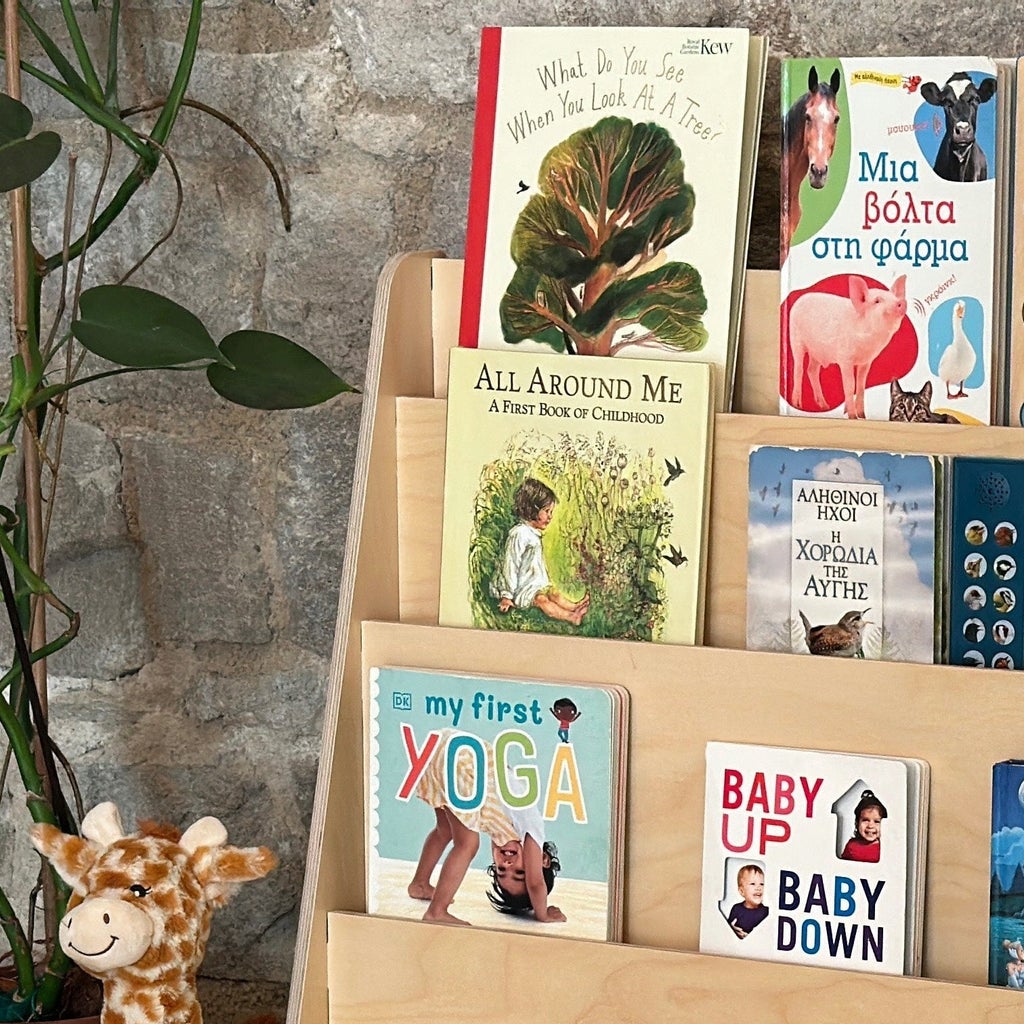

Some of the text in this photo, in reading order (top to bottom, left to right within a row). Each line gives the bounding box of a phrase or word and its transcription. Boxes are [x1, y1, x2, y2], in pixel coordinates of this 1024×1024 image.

[701, 38, 733, 55] Kew
[537, 46, 684, 90] What Do You See
[507, 109, 555, 144] When
[558, 90, 584, 119] You
[591, 78, 627, 111] Look
[633, 83, 655, 111] At
[662, 92, 676, 118] A
[858, 151, 919, 183] Μια
[862, 187, 956, 230] βόλτα
[811, 229, 969, 267] στη φάρμα
[474, 363, 683, 404] ALL AROUND ME
[488, 399, 665, 425] A FIRST BOOK OF CHILDHOOD
[796, 487, 878, 508] ΑΛΗΘΙΝΟΙ
[817, 505, 857, 522] ΗΧΟΙ
[795, 539, 879, 566] ΧΟΡΩΔΙΑ
[831, 531, 841, 543] Η
[803, 574, 869, 601] ΑΥΓΗΣ
[823, 565, 849, 579] ΤΗΣ
[394, 694, 411, 709] DK
[425, 692, 543, 727] my first
[395, 722, 588, 824] YOGA
[722, 768, 825, 818] BABY
[721, 813, 791, 855] UP
[778, 869, 886, 921] BABY
[777, 915, 884, 963] DOWN
